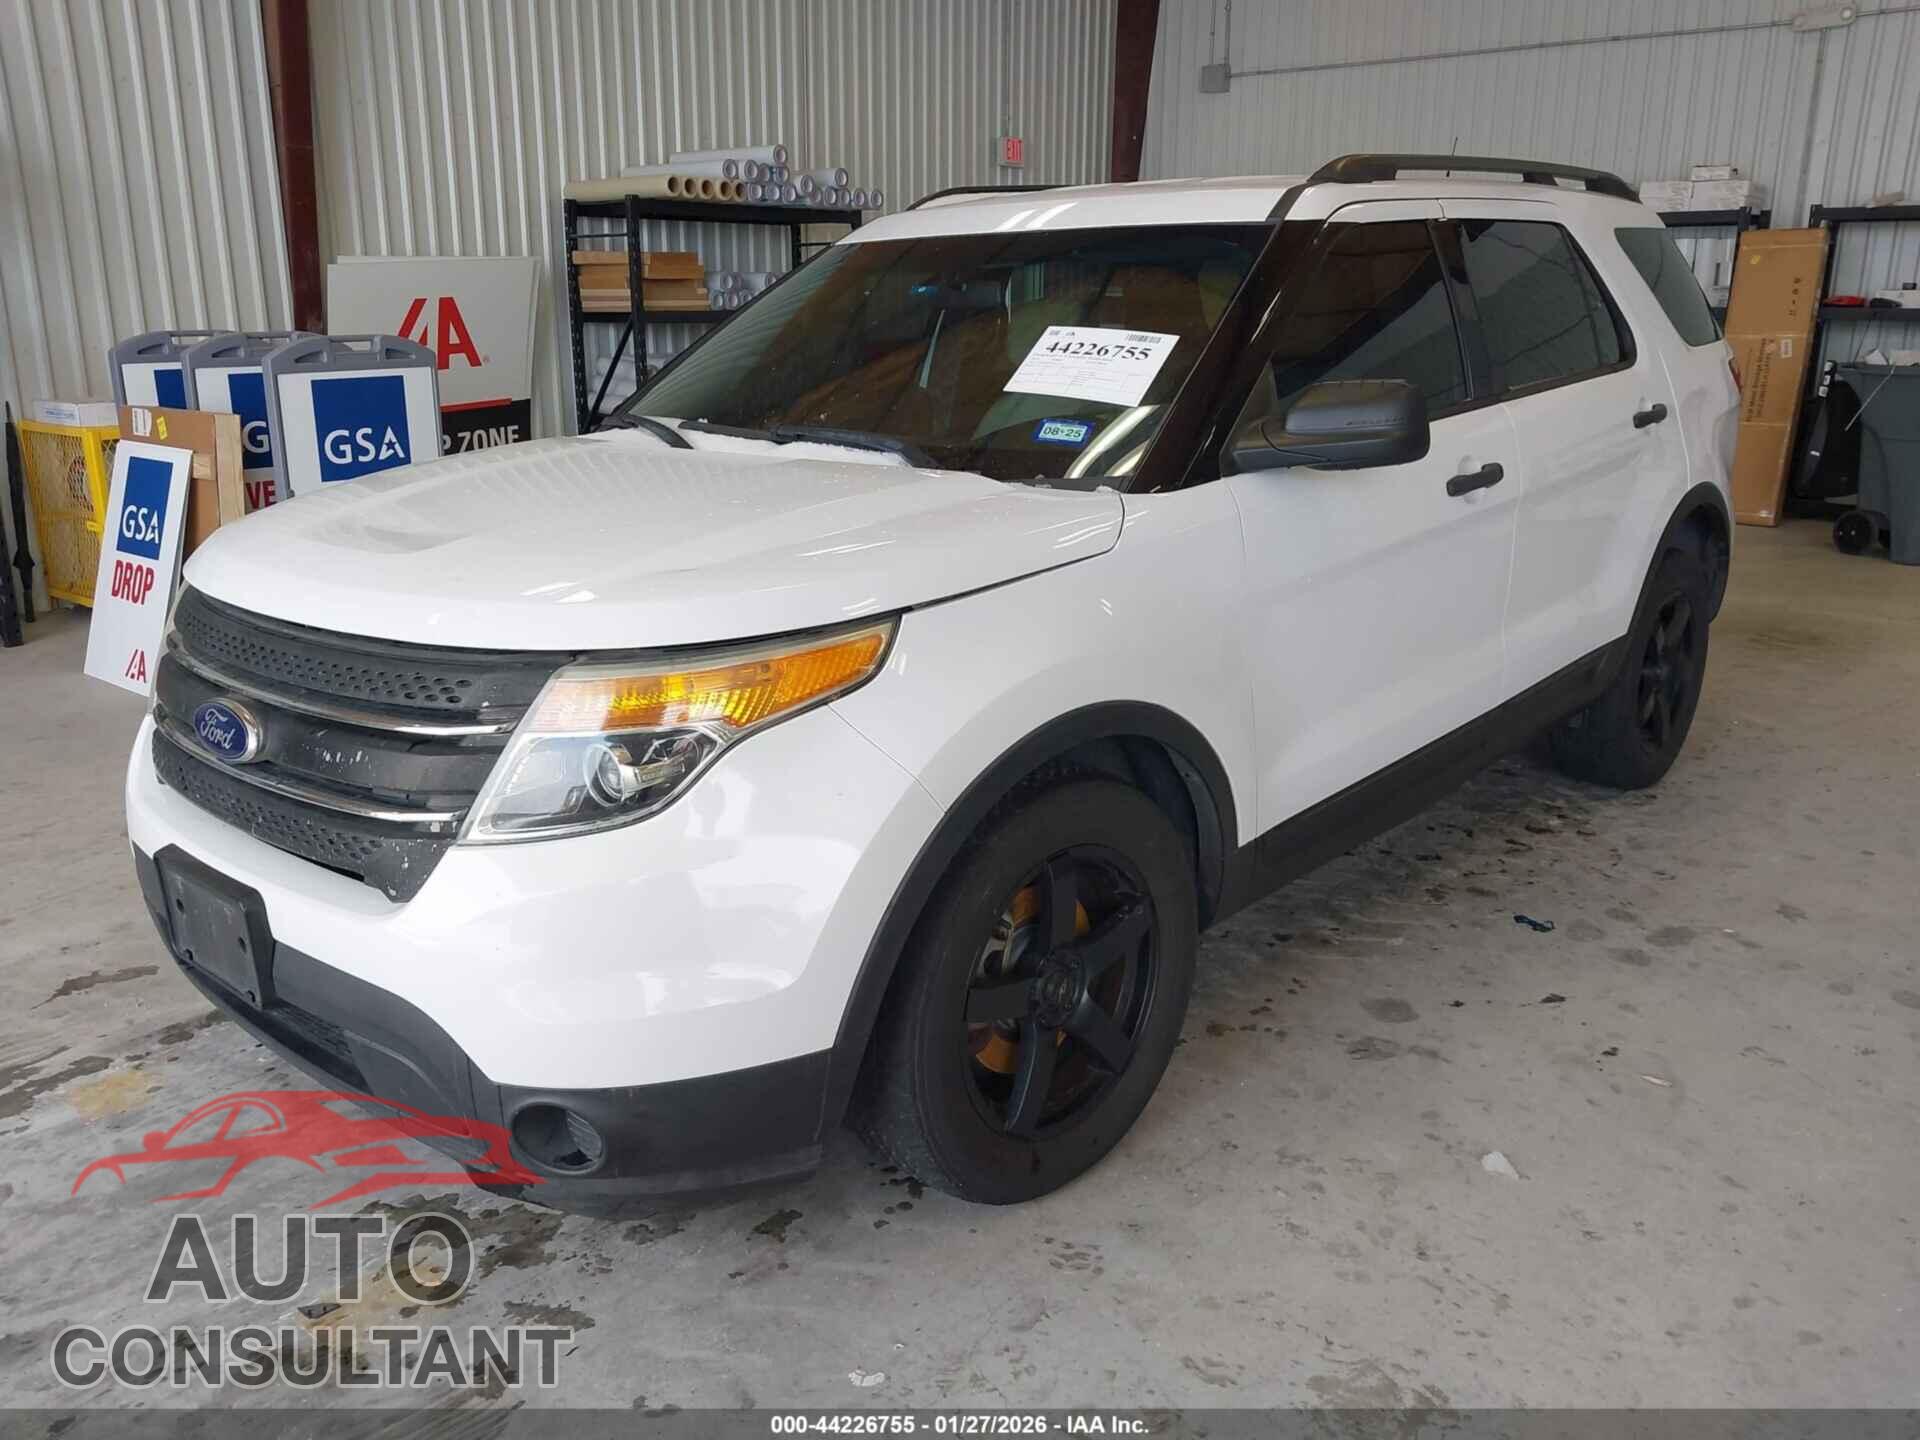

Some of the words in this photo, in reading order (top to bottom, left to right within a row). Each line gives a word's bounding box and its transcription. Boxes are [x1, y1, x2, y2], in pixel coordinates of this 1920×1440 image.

[1046, 341, 1152, 361] 44226755
[324, 425, 405, 465] GSA
[122, 504, 160, 544] GSA
[111, 559, 155, 606] DROP
[200, 708, 236, 750] Ford
